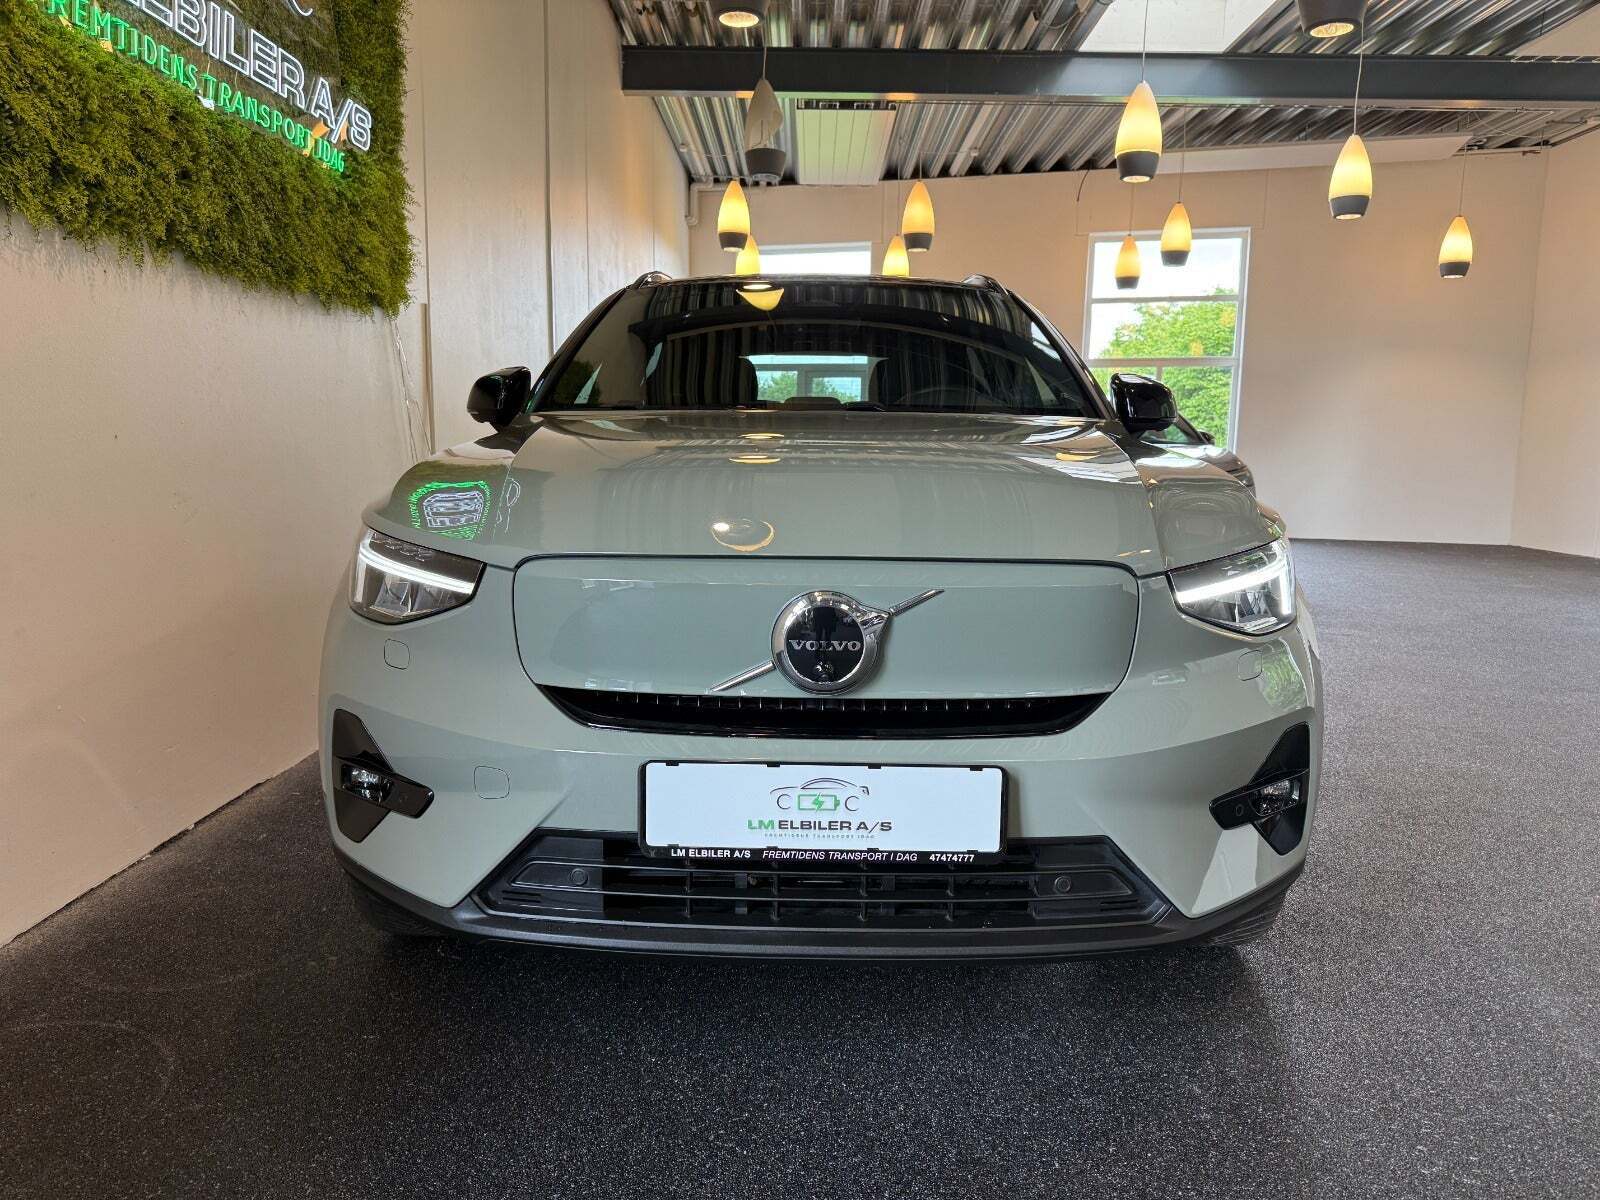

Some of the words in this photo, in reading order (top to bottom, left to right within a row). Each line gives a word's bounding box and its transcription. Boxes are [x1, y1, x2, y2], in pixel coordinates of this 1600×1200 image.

[200, 72, 313, 152] TRANSPORT
[310, 76, 372, 151] A/S
[788, 639, 862, 651] VOLVO
[747, 819, 775, 830] LM
[778, 820, 852, 831] ELBILER
[856, 821, 893, 834] A/S
[671, 848, 686, 857] LM
[688, 848, 731, 858] ELBILER
[733, 849, 751, 859] A/S
[762, 850, 826, 860] FREMTIDENS
[828, 851, 888, 861] TRANSPORT
[895, 852, 918, 862] DAG
[929, 853, 975, 863] 47474777
